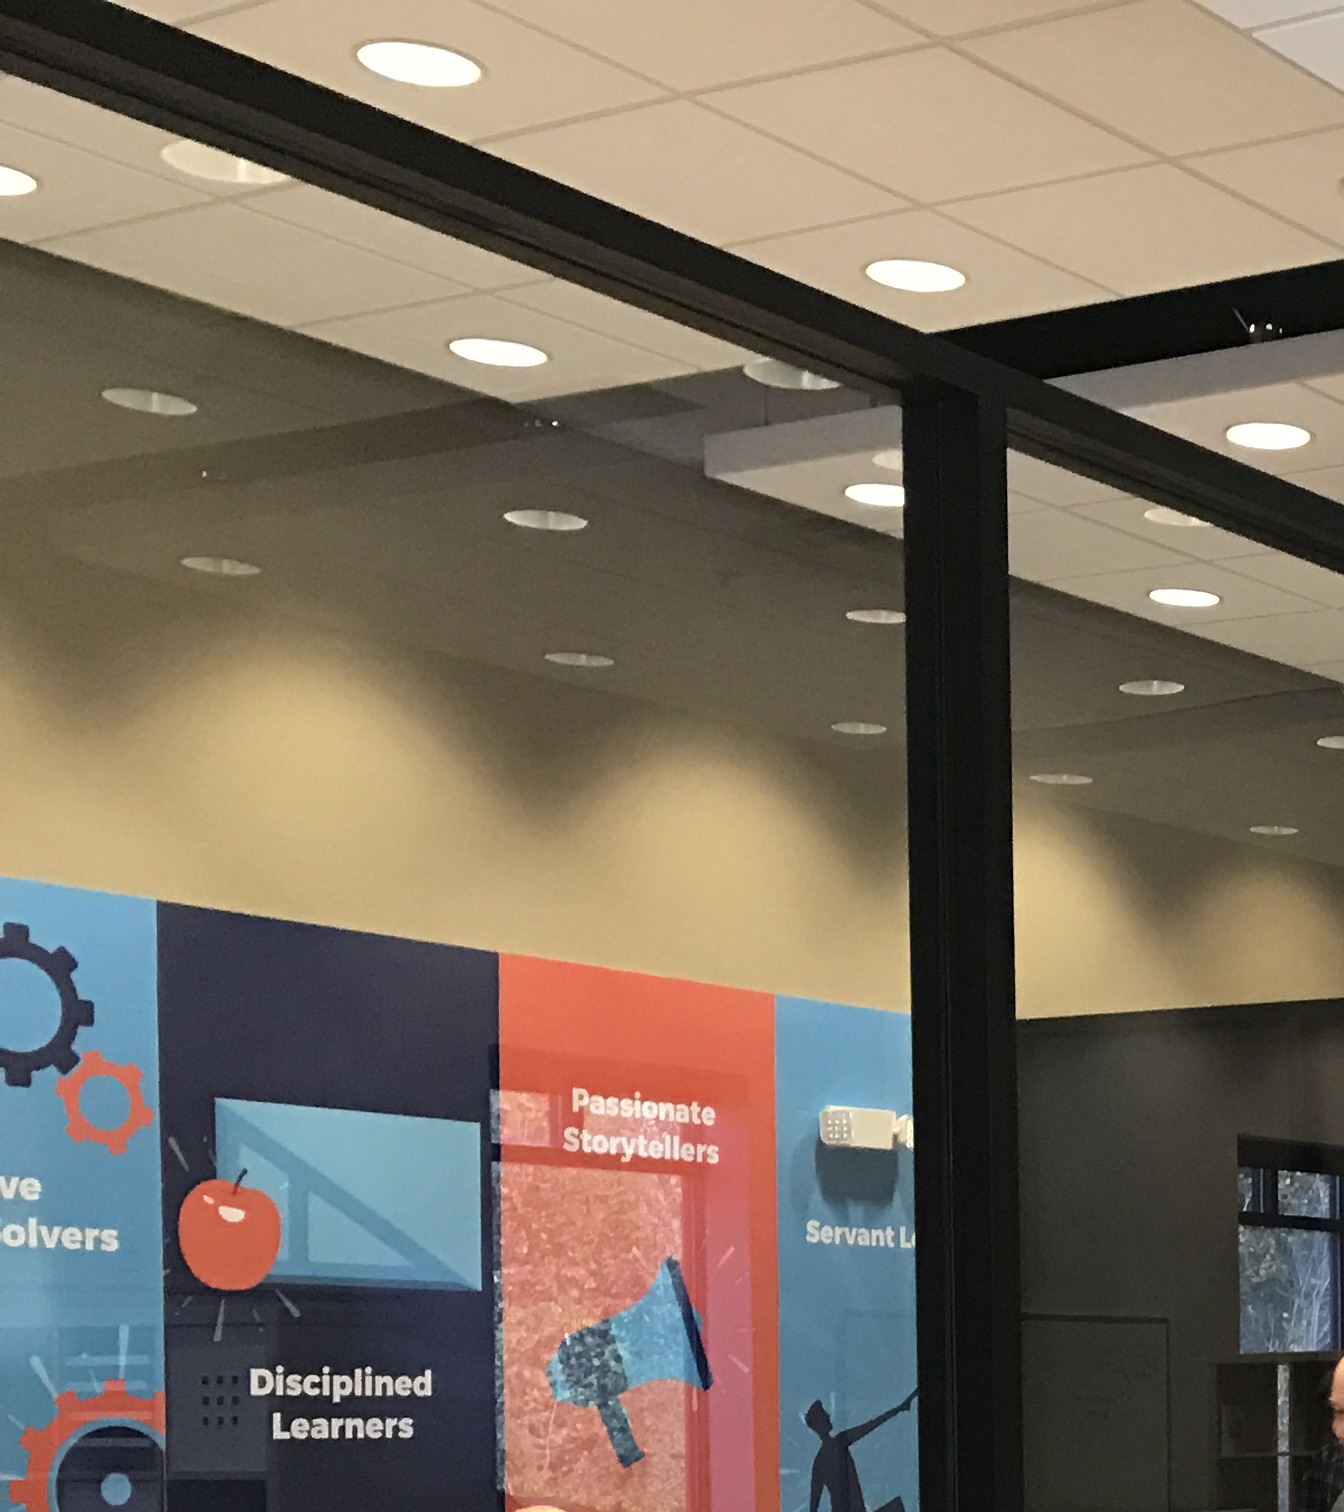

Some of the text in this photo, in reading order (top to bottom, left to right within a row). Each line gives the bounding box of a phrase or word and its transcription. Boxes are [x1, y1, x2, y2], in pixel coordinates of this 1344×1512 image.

[571, 1086, 717, 1127] Passionate
[562, 1126, 720, 1165] Storytellers
[0, 1175, 42, 1201] ve
[0, 1217, 119, 1252] olvers
[805, 1219, 895, 1248] Servant
[249, 1364, 433, 1404] Disciplined
[272, 1411, 415, 1440] Learners
